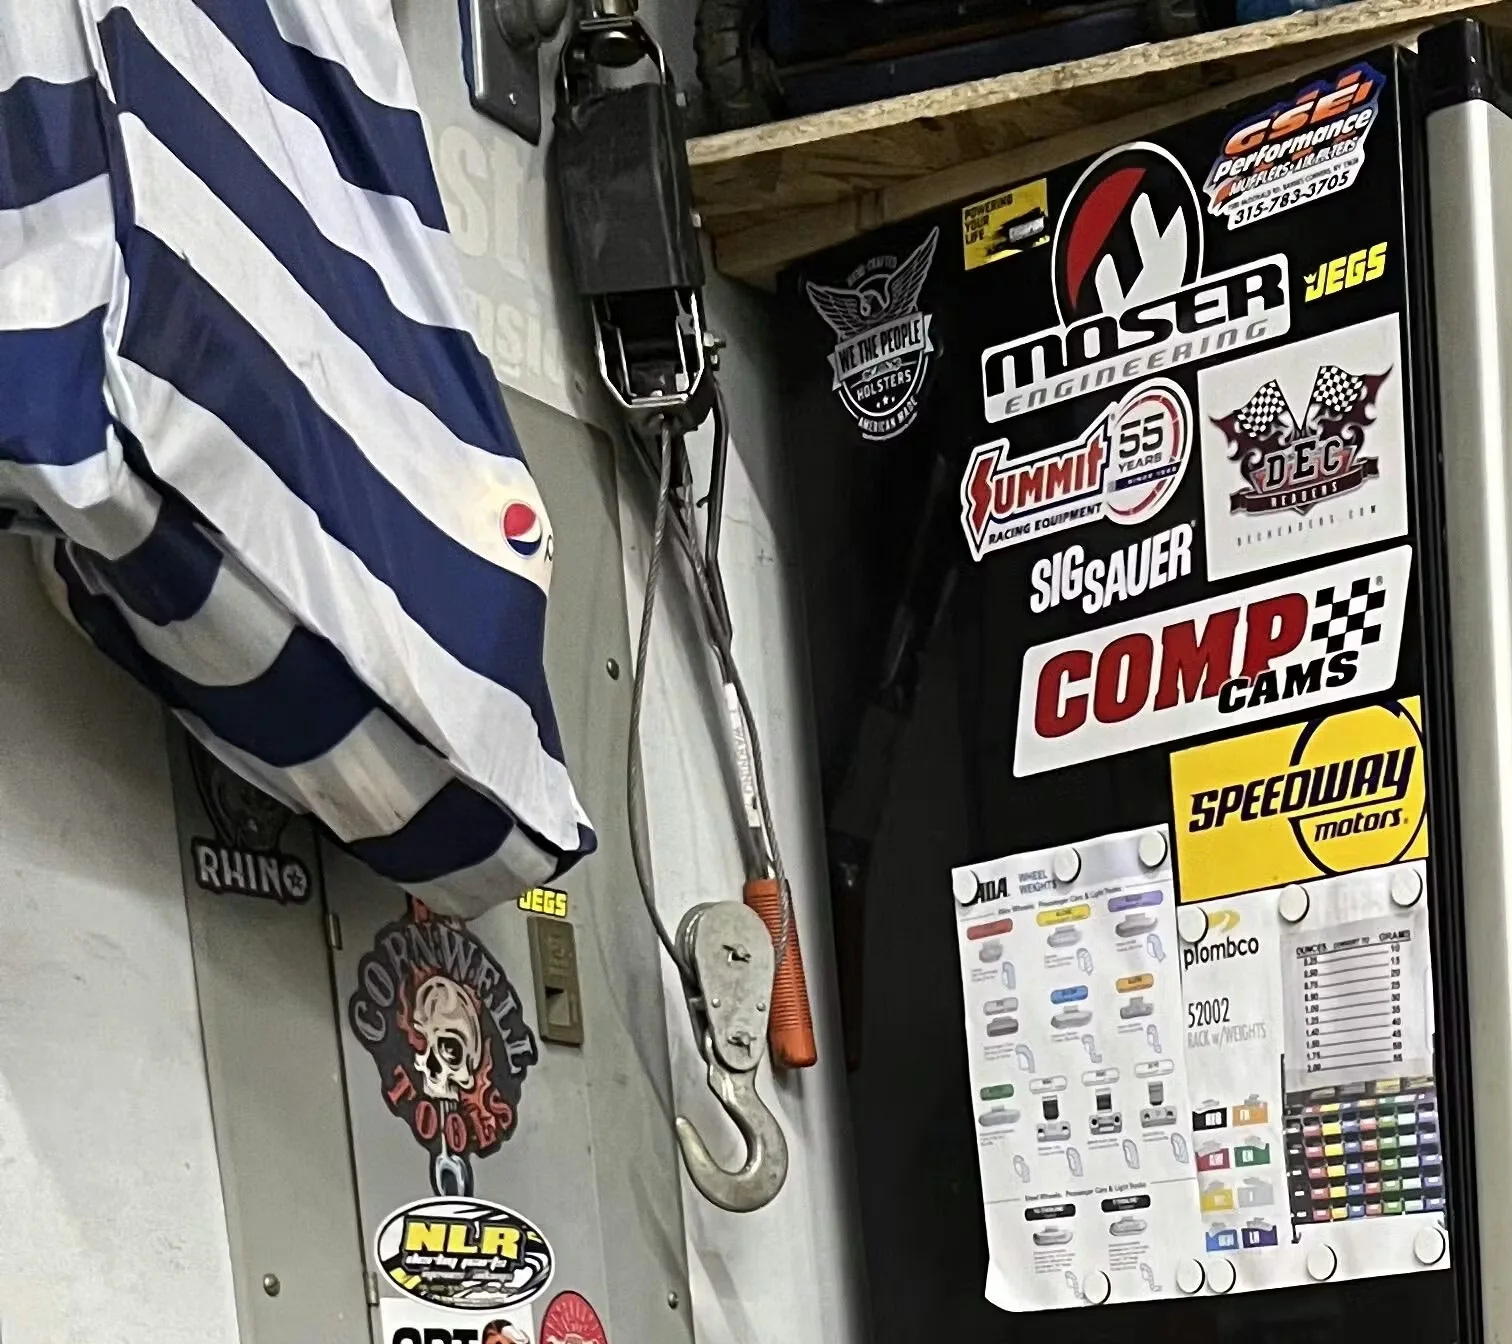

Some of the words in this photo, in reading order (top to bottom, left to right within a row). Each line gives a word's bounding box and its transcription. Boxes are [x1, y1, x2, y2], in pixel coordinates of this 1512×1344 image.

[1235, 171, 1350, 225] 315-783-3705
[1305, 241, 1388, 302] JEGS
[858, 337, 879, 362] THE
[880, 319, 921, 356] PEOPLE
[985, 263, 1286, 398] MOSER
[856, 369, 912, 401] HOLSTERS
[1004, 318, 1268, 416] ENGINEERING
[1119, 412, 1165, 459] 55
[1118, 452, 1163, 473] YEARS
[1265, 438, 1343, 489] DEC
[988, 524, 1031, 545] RACING
[1034, 503, 1102, 532] EQUIPMENT
[1030, 545, 1085, 613] SIG
[1082, 522, 1194, 614] SAUER
[1035, 593, 1309, 738] COMP
[1218, 650, 1359, 714] CAMS
[1189, 746, 1417, 833] SPEEDWAY
[198, 845, 307, 897] RHINO
[1018, 869, 1048, 882] WHEEL
[1018, 879, 1058, 895] WEIGHTS
[519, 887, 568, 917] JEGS
[1183, 935, 1260, 970] plombco
[1188, 997, 1230, 1028] 52002
[388, 1064, 513, 1153] TOOLS
[404, 1220, 521, 1260] NLR
